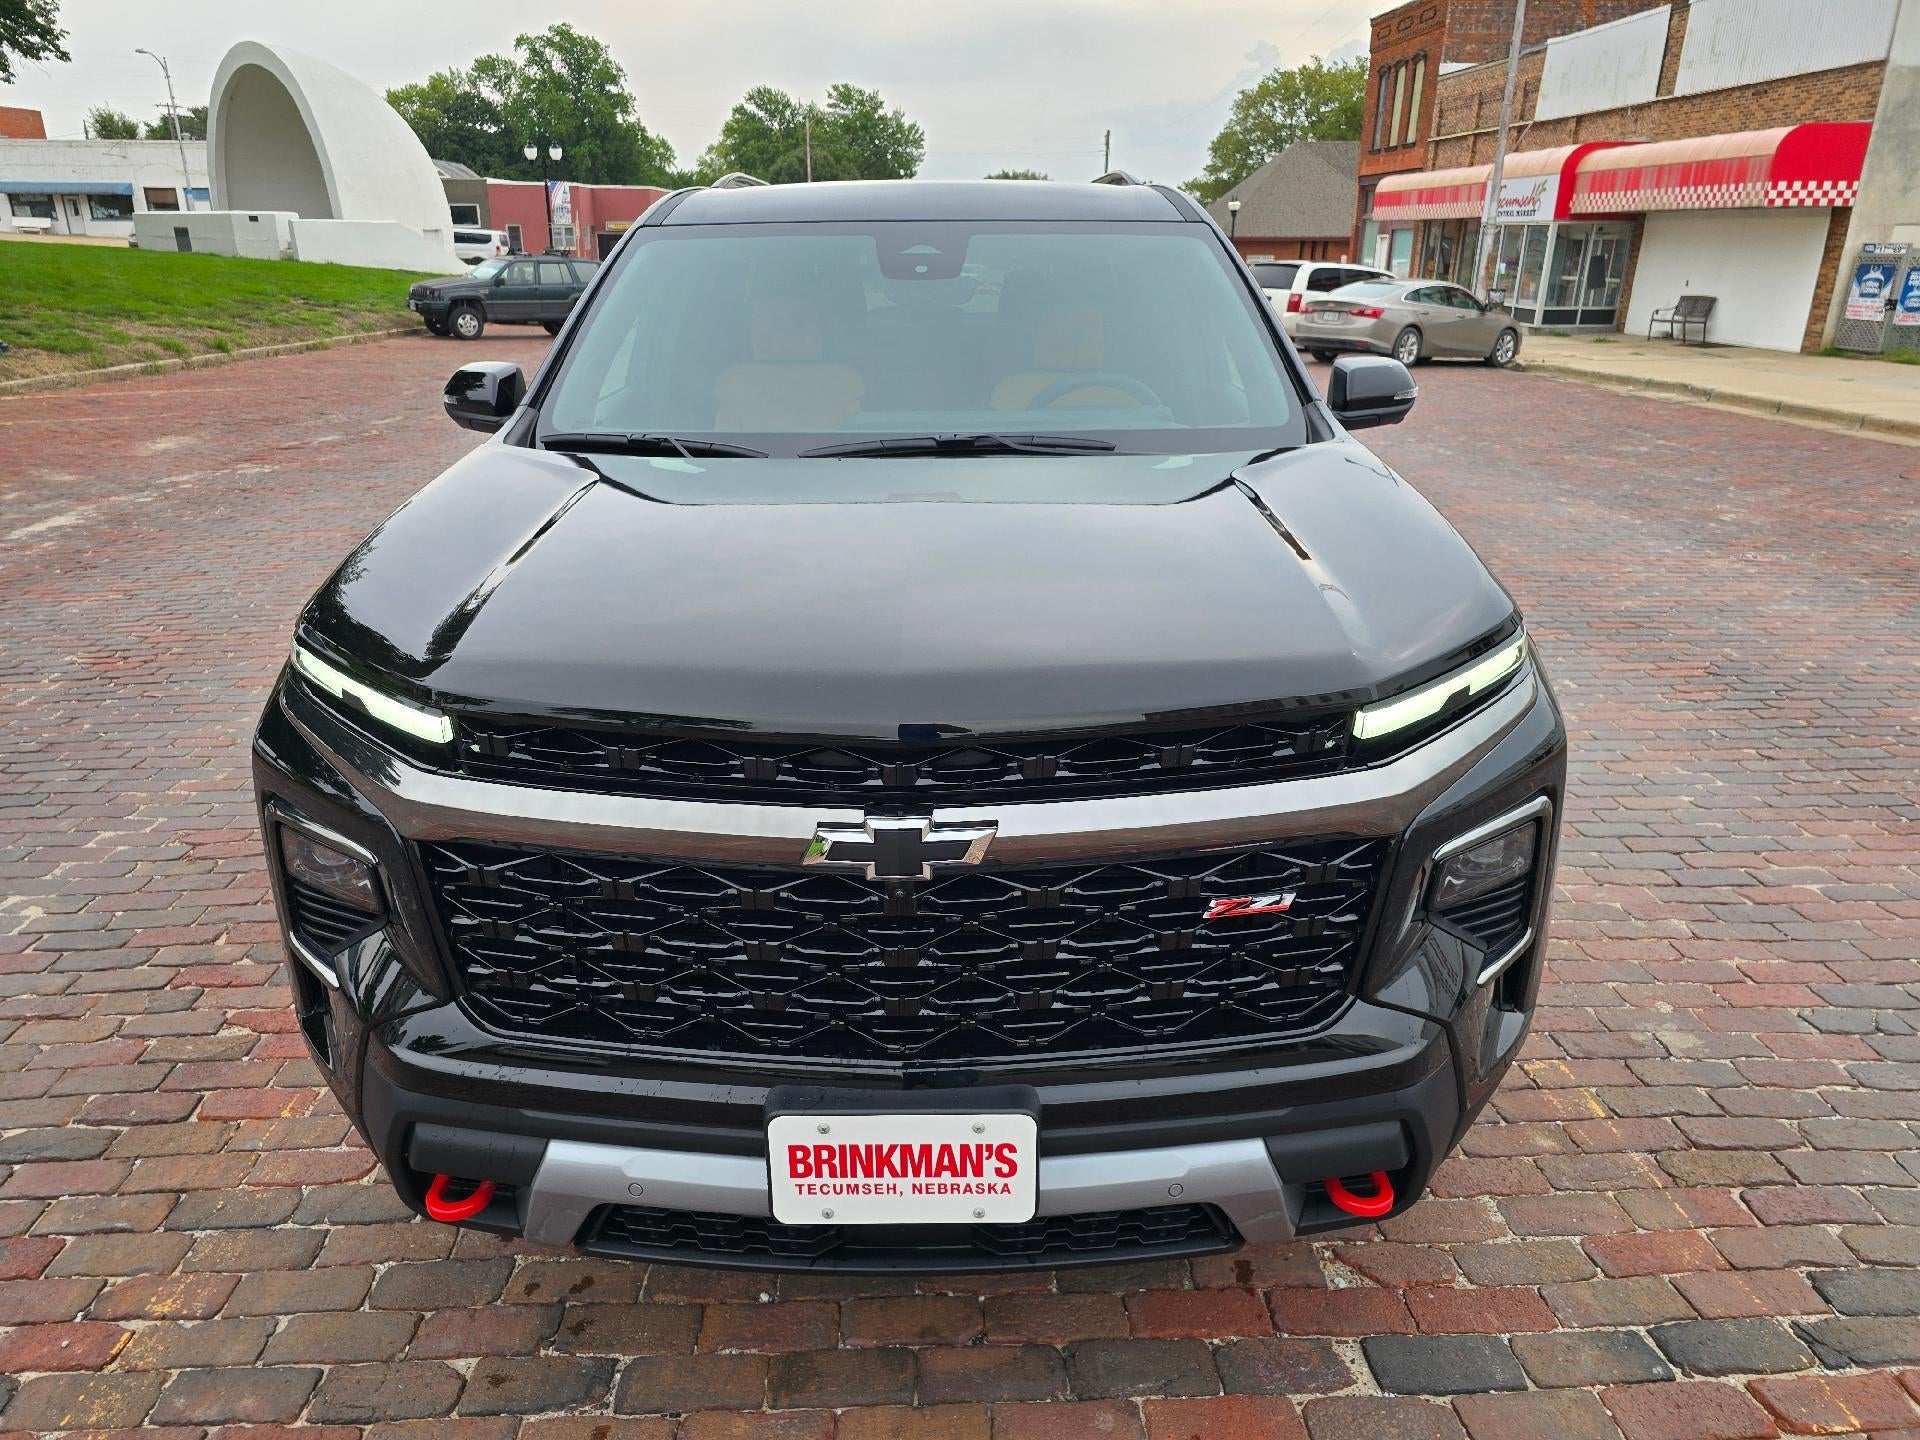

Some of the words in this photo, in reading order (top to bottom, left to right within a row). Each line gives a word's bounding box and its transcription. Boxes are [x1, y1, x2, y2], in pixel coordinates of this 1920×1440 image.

[1515, 209, 1536, 217] MARKET
[1203, 893, 1296, 918] Z71
[788, 1143, 1018, 1178] BRINKMAN'S
[795, 1183, 903, 1197] TECUMSEH,
[912, 1183, 1011, 1195] NEBRASKA
